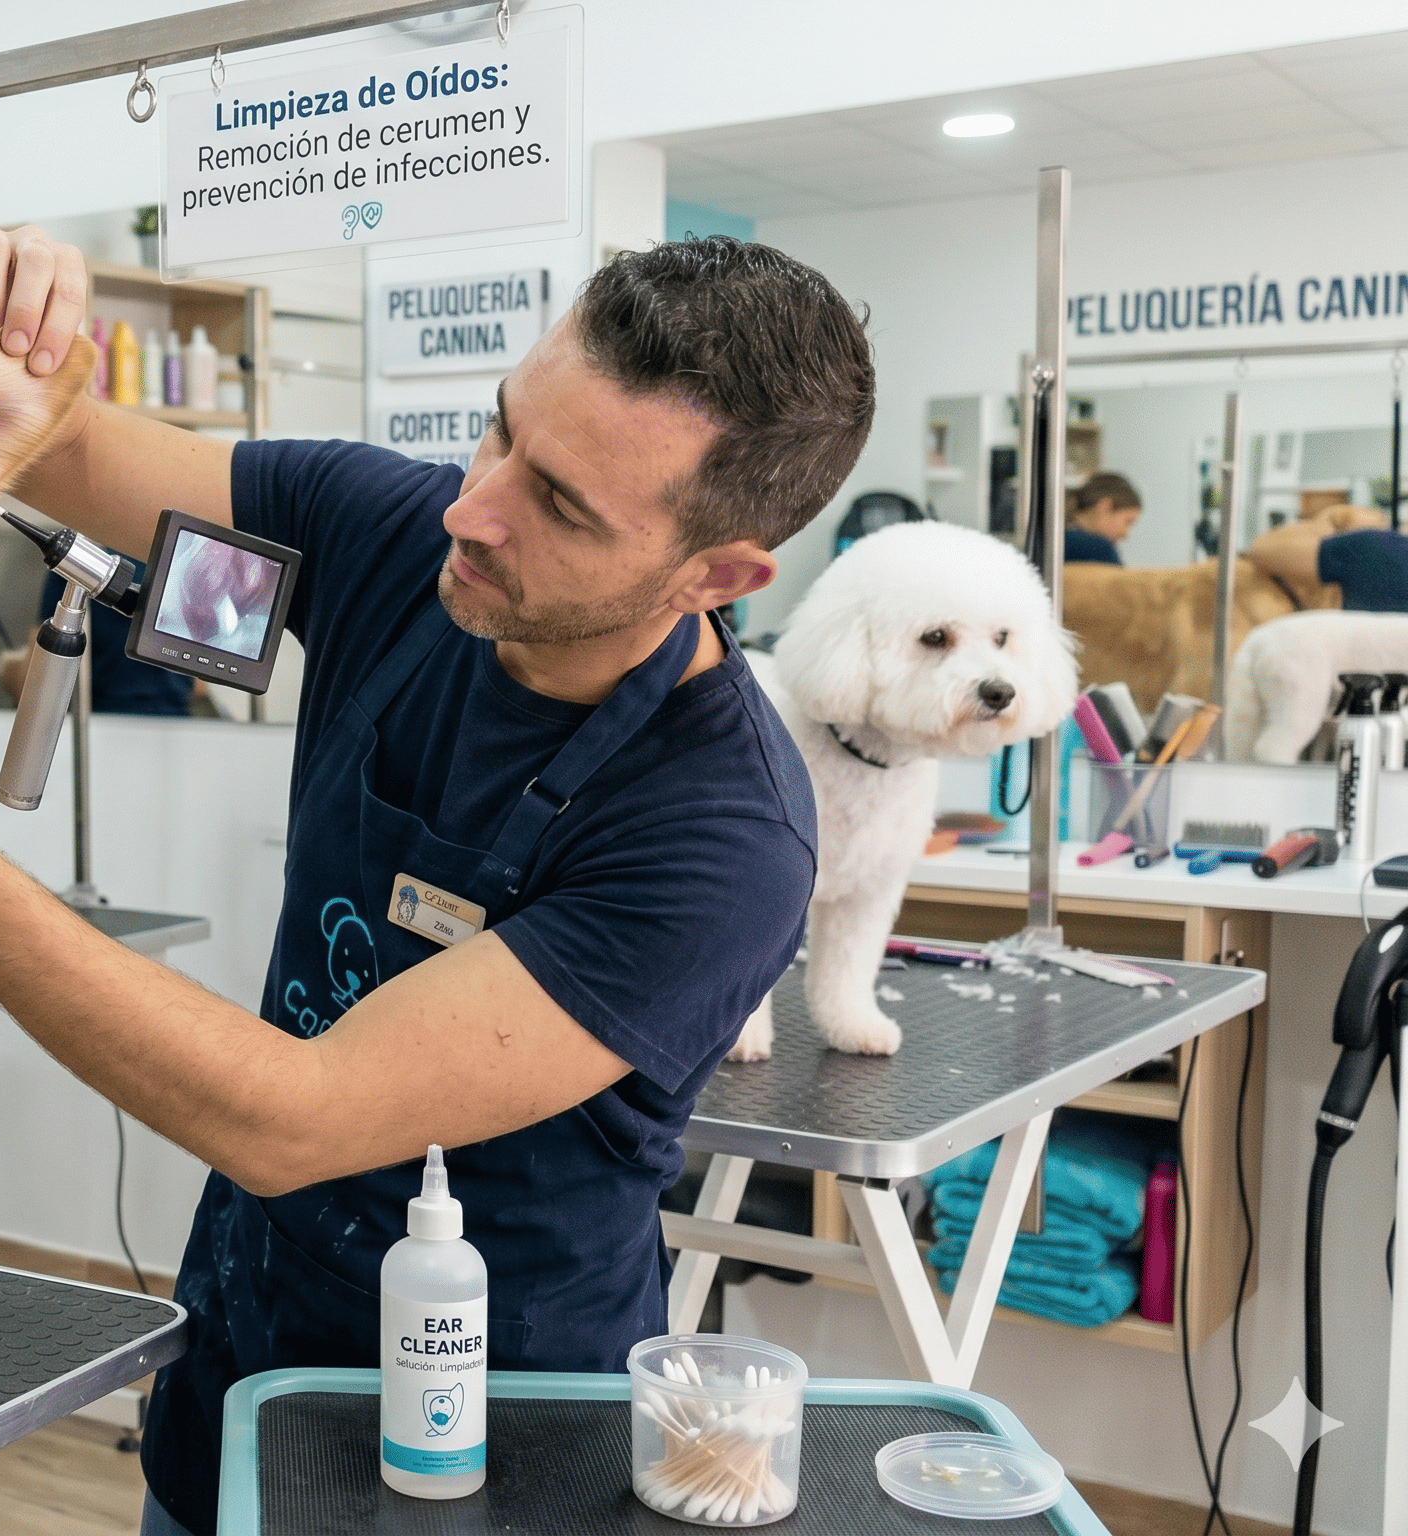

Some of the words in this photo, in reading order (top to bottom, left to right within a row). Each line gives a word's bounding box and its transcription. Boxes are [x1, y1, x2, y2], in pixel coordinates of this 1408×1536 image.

[216, 90, 349, 132] Limpieza
[358, 75, 396, 109] de
[405, 62, 509, 101] Oídos:
[198, 129, 328, 172] Remoción
[338, 123, 371, 152] de
[379, 108, 505, 146] cerumen
[514, 104, 531, 135] y
[183, 167, 324, 217] prevención
[333, 161, 367, 190] de
[376, 143, 550, 185] infecciones.
[389, 273, 530, 321] PELUQUERÍA
[420, 321, 506, 358] CANINA
[390, 410, 461, 442] CORTE
[400, 1335, 483, 1356] CLEANER
[424, 1317, 463, 1334] EAR
